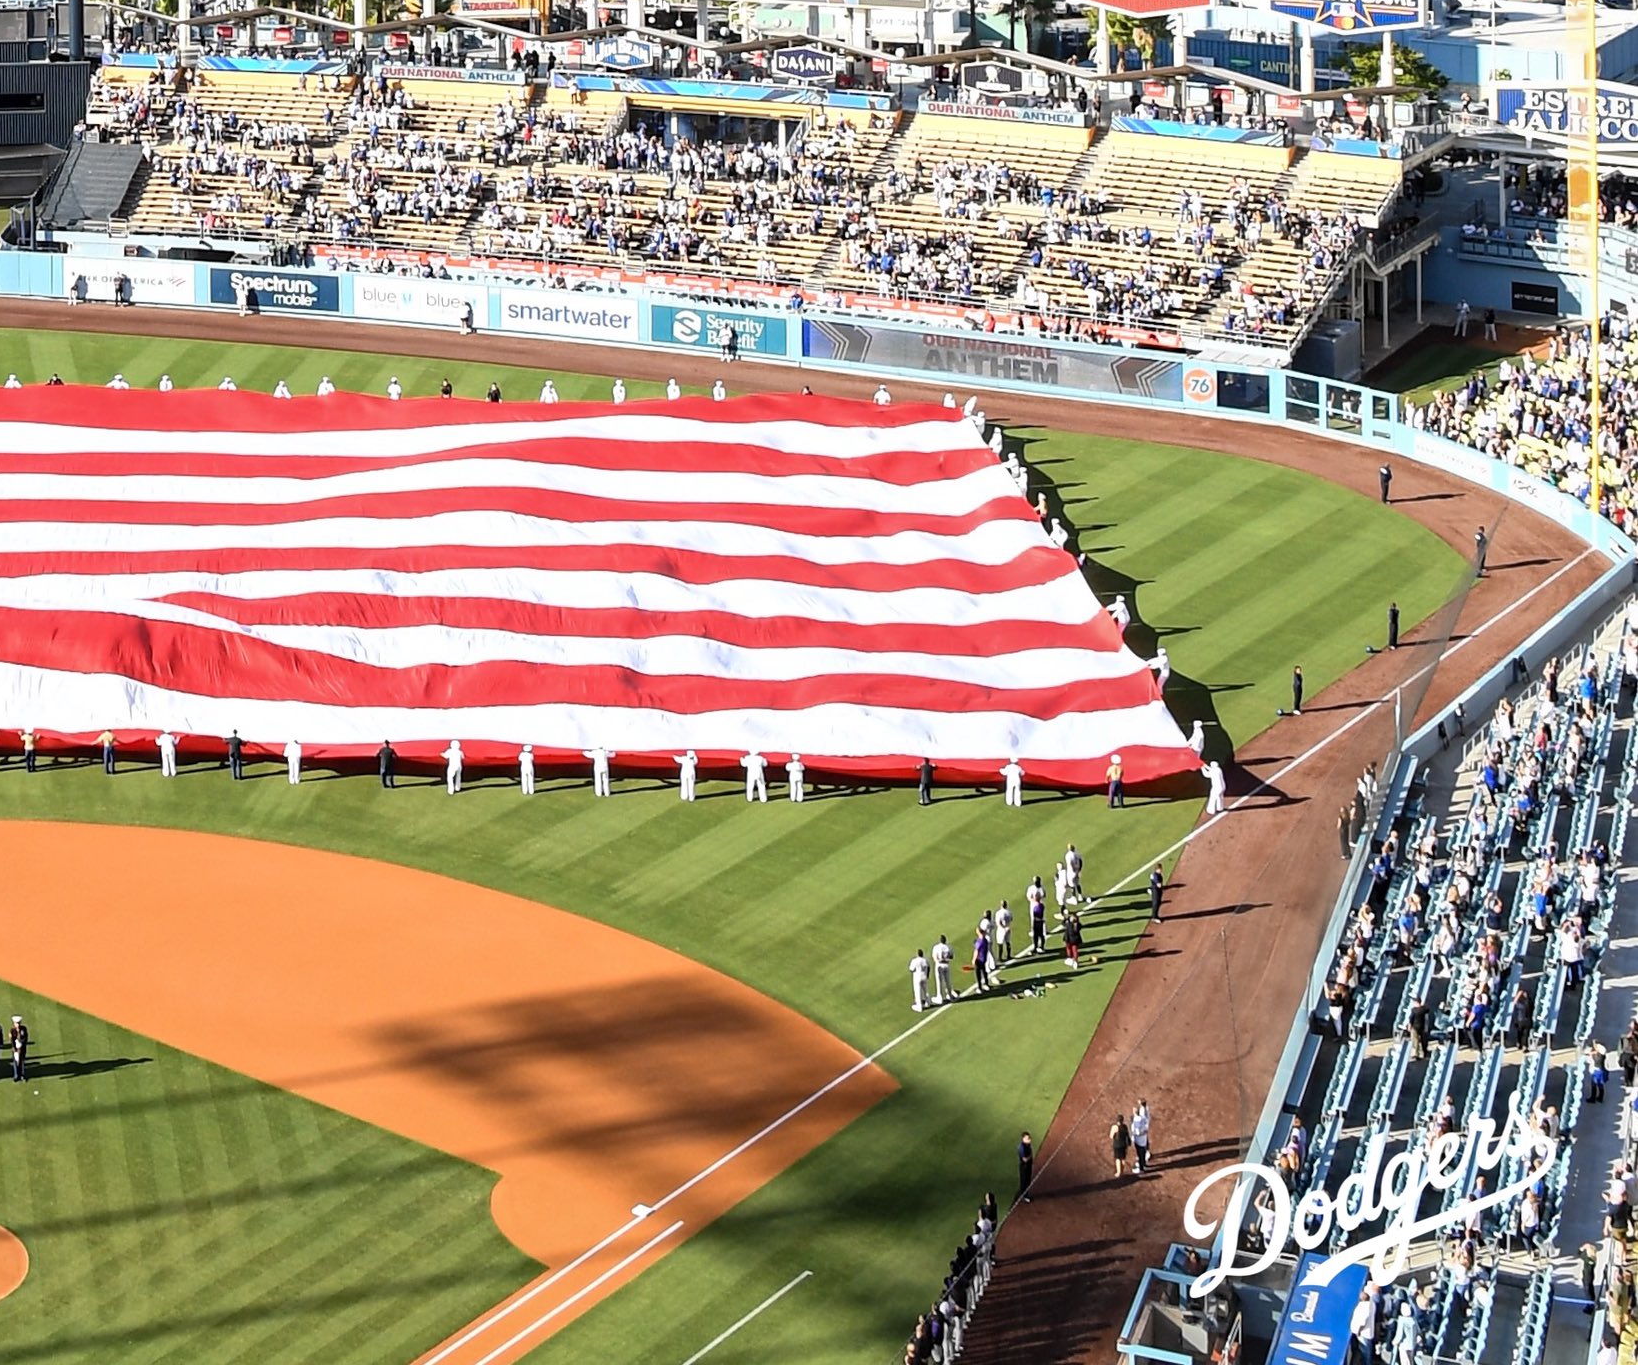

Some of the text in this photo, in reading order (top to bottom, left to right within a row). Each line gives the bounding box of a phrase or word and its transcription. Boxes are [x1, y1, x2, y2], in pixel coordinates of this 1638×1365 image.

[778, 55, 832, 74] DASANI
[1261, 59, 1300, 76] CANTIA
[381, 67, 516, 83] OUR NATIONAL ANTHEM
[927, 102, 1074, 124] OUR NATIONAL ANTHEM
[230, 272, 313, 295] Spectrum
[273, 293, 312, 306] mobile
[363, 287, 397, 303] blue
[426, 292, 461, 308] blue
[507, 301, 632, 330] smartwater
[922, 333, 1058, 361] OUR NATIONAL
[922, 347, 1059, 385] ANTHEM
[1188, 378, 1210, 394] 76
